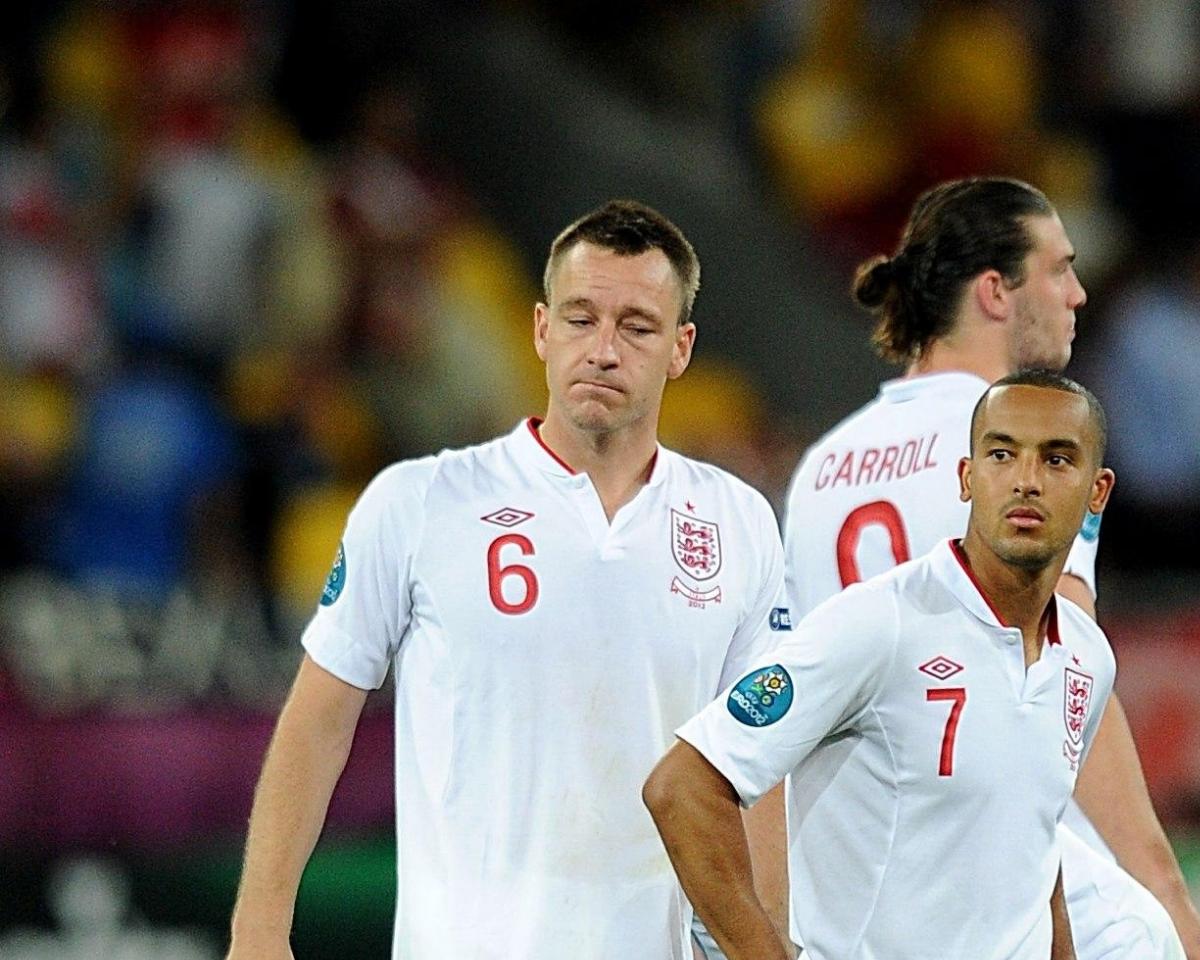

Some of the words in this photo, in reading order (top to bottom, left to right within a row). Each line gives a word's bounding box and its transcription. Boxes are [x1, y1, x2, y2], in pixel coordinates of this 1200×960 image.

[815, 433, 938, 491] CARROLL
[487, 533, 539, 615] 6
[926, 687, 966, 777] 7
